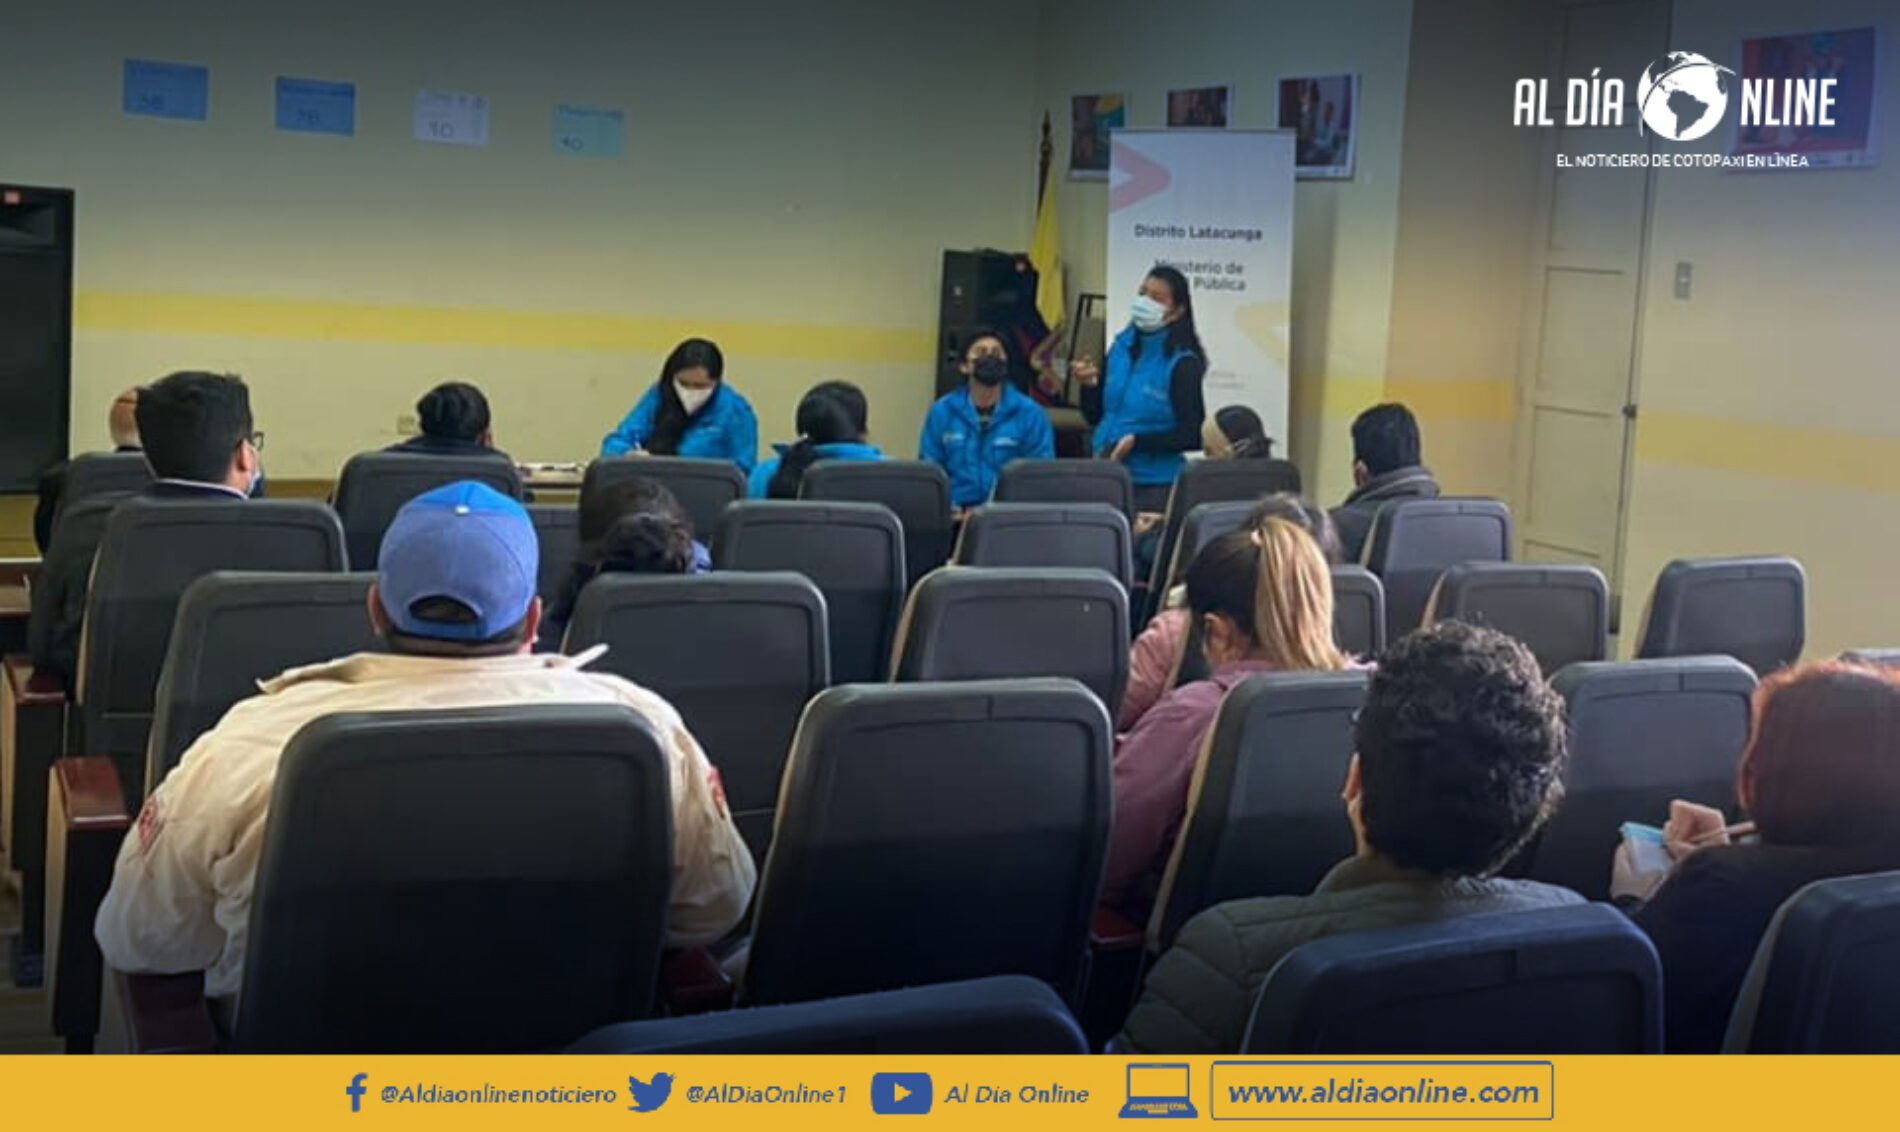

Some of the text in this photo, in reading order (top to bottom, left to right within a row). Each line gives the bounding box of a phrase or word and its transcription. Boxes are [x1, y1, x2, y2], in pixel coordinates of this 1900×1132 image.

[1135, 224, 1263, 242] Distrito Latacunga
[1225, 260, 1244, 274] de
[1193, 274, 1247, 291] Pública
